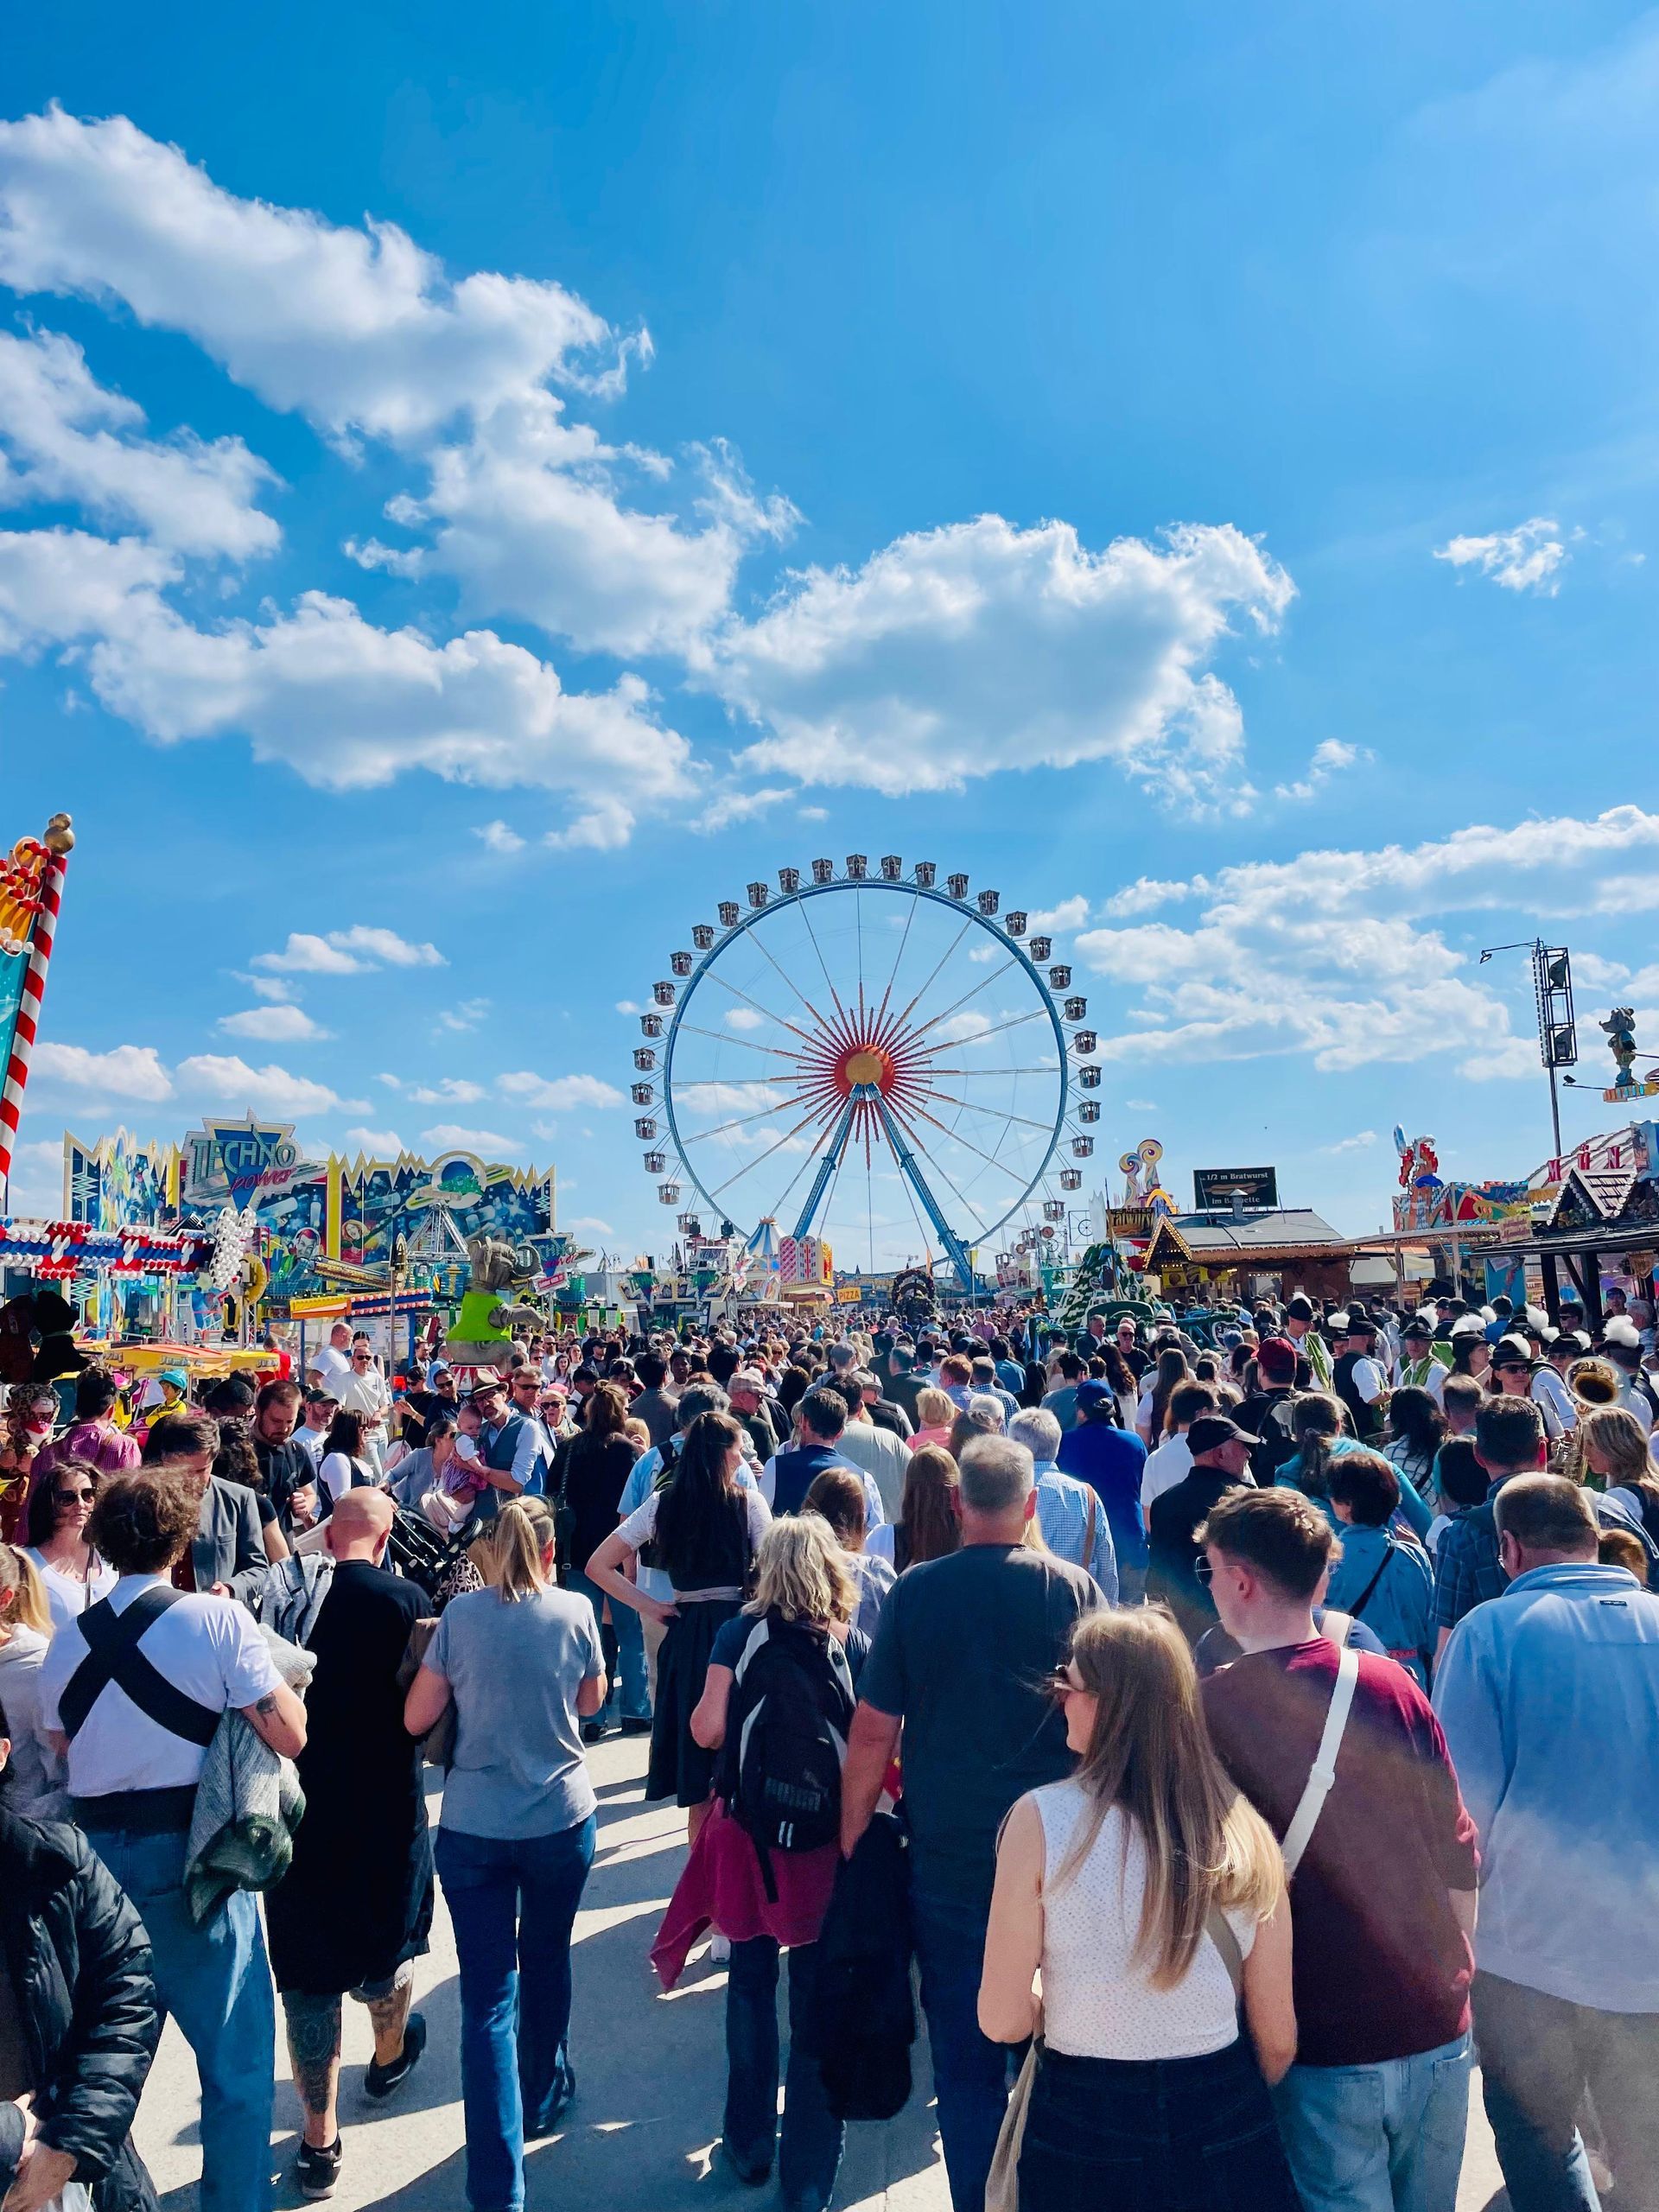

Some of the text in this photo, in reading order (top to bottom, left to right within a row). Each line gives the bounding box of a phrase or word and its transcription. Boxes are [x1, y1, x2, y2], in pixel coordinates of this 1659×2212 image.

[191, 1124, 296, 1184] TECHNO
[230, 1168, 296, 1192] power
[1111, 1212, 1154, 1230] ratwurst
[839, 1289, 860, 1300] PIZZA
